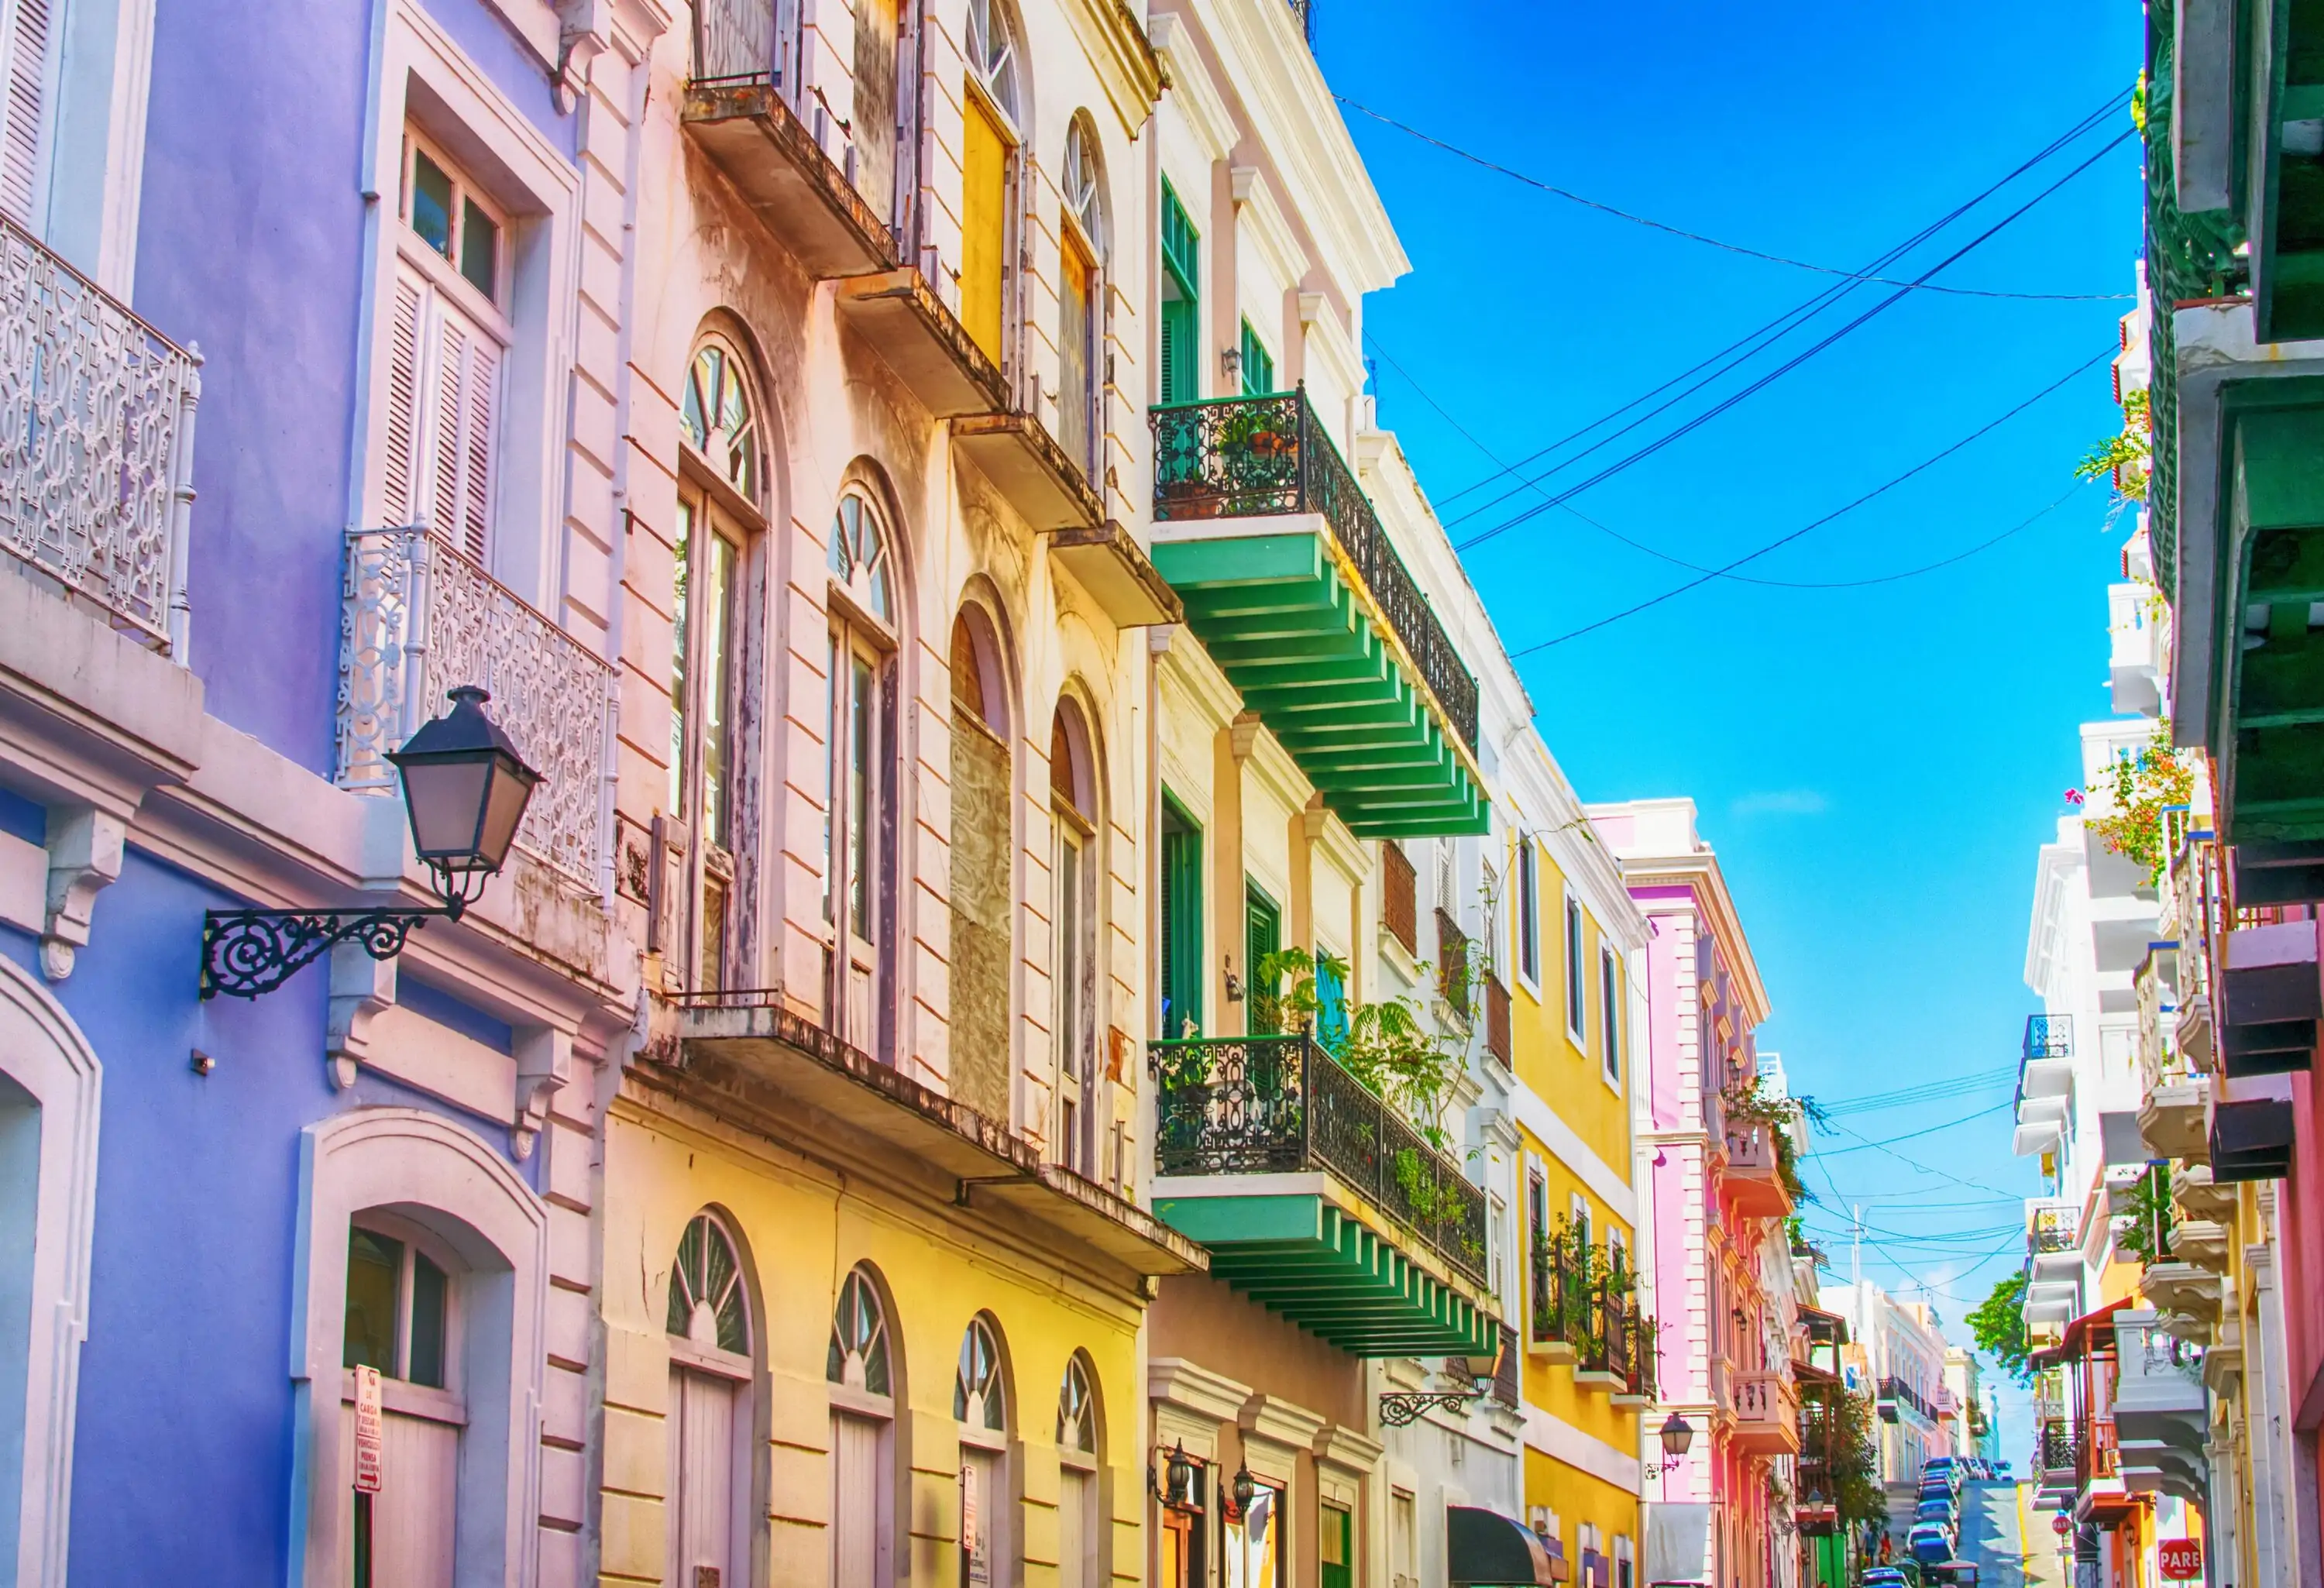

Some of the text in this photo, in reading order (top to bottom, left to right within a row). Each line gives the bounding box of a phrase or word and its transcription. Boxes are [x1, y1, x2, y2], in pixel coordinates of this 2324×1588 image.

[359, 1402, 377, 1415] CARGA
[361, 1451, 376, 1463] PRENSA
[2161, 1551, 2200, 1568] PARE
